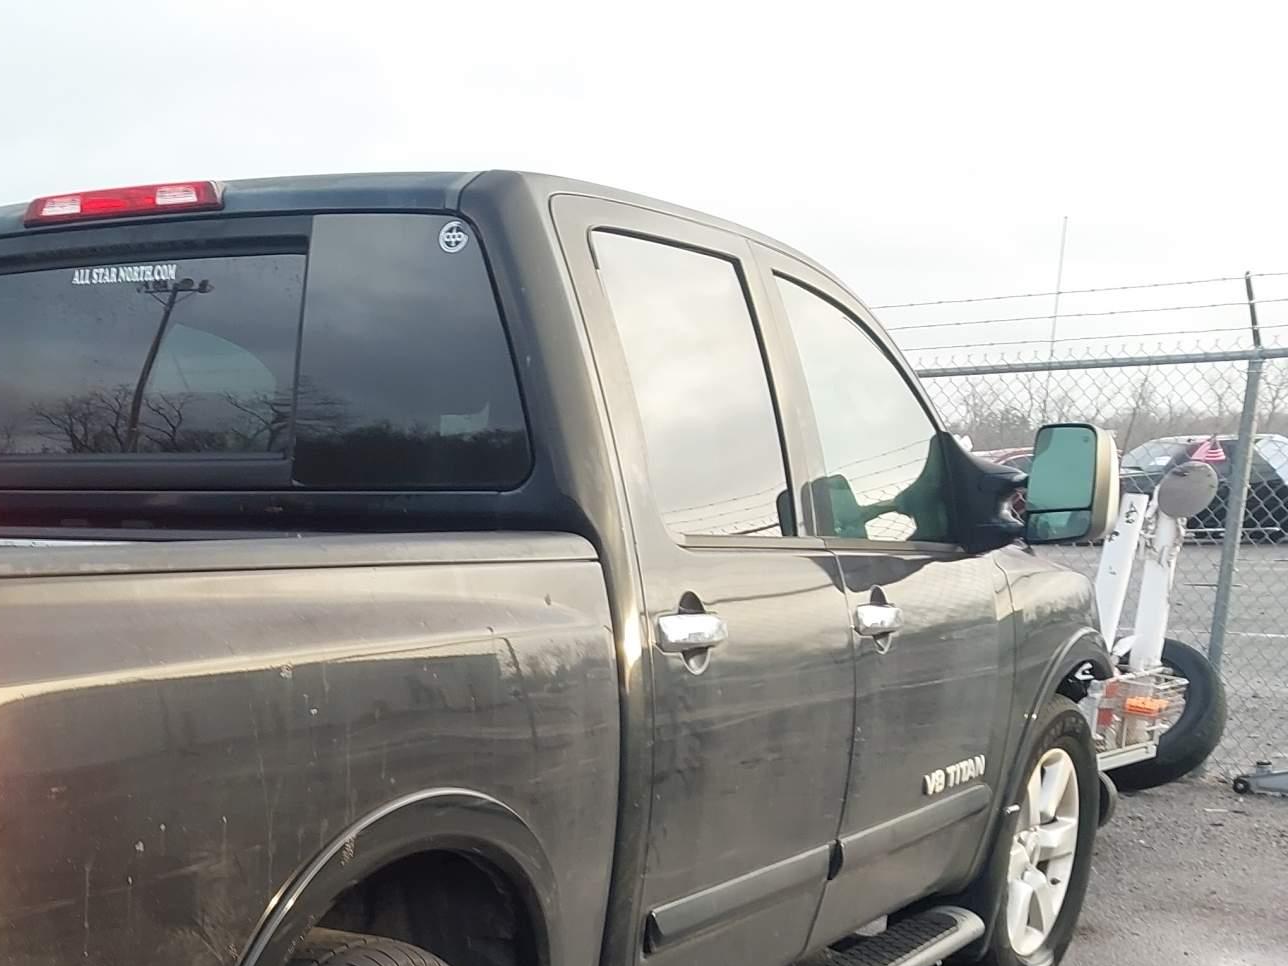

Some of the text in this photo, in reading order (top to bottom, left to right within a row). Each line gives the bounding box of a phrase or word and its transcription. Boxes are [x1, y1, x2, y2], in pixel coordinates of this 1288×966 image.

[92, 267, 117, 283] STAR
[922, 754, 986, 795] V8 TITAN
